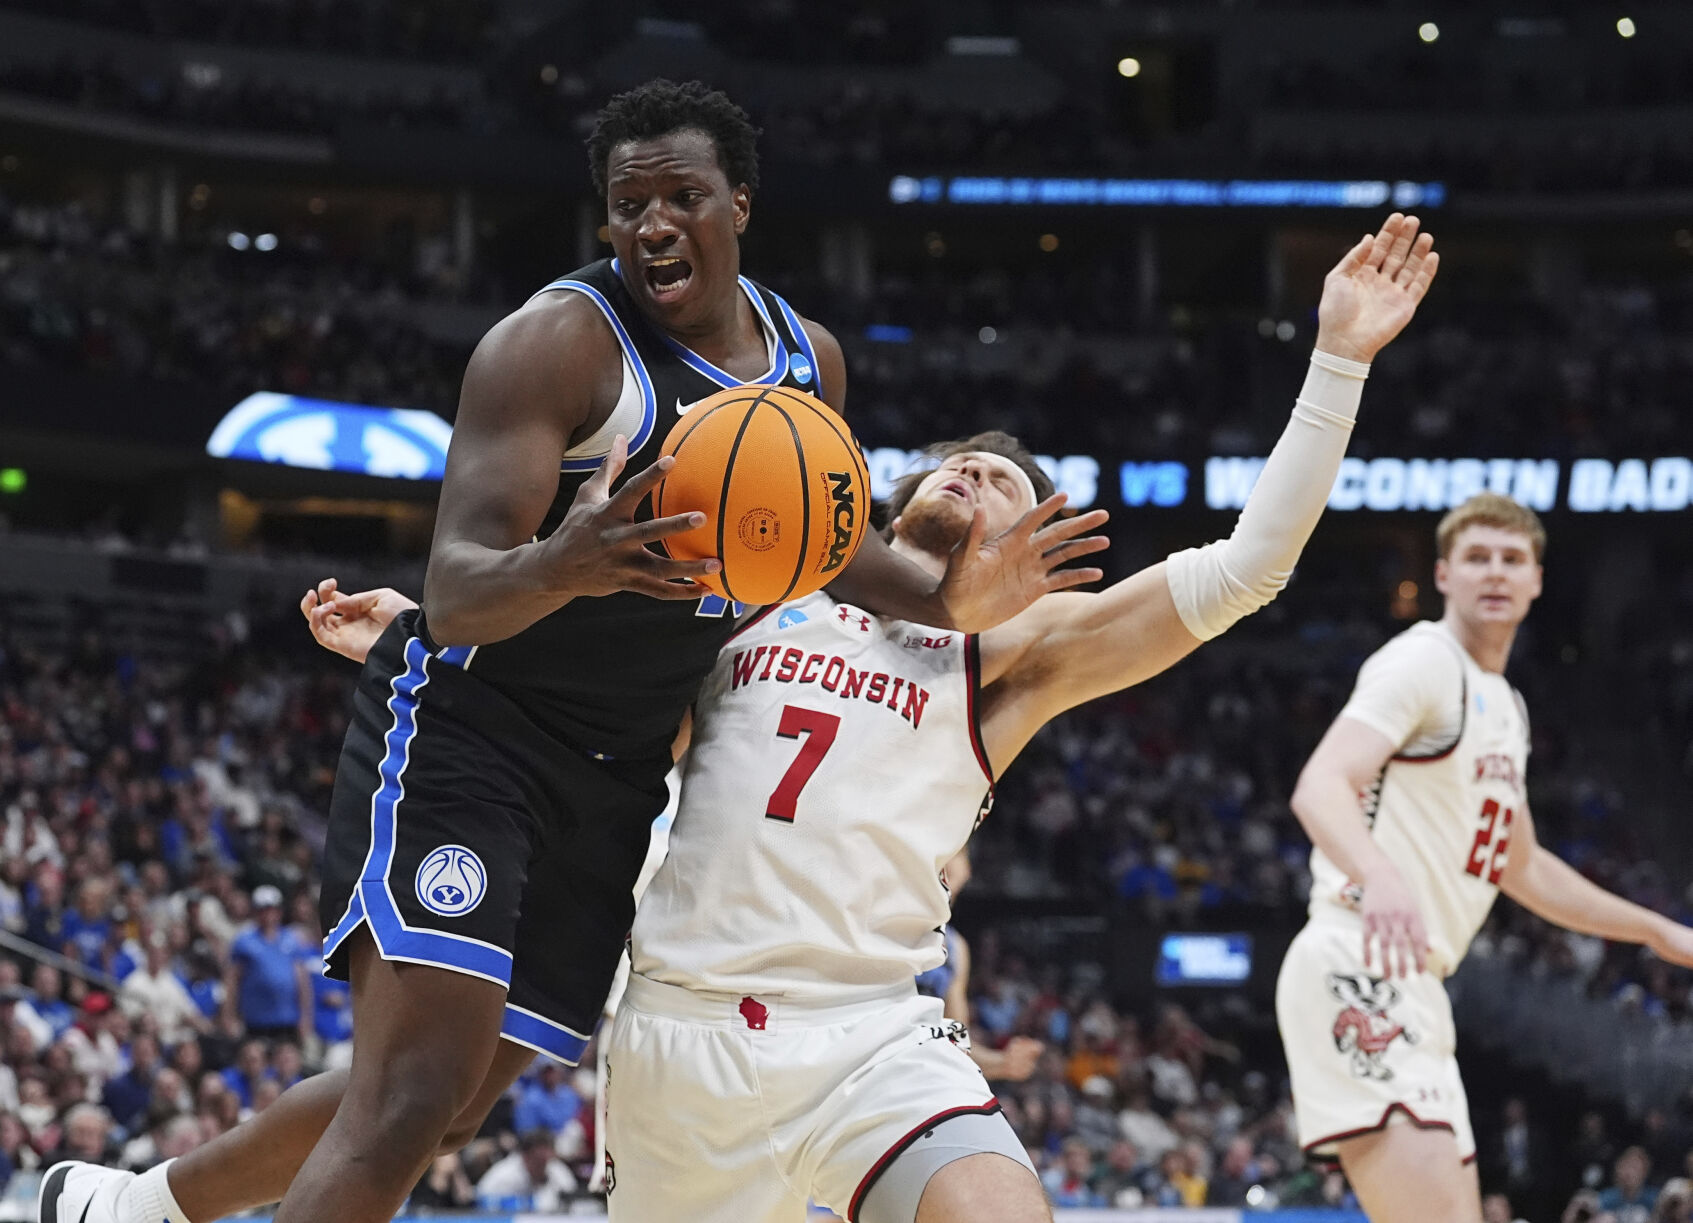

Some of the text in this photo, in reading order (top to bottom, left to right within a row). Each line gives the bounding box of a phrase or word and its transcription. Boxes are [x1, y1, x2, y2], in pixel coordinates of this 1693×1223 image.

[813, 472, 831, 575] OFFICIAL GAME BALL
[820, 472, 855, 573] NCAA
[1119, 461, 1188, 507] VS
[1205, 456, 1559, 512] WCONSIN
[731, 645, 931, 730] WISCONSIN
[764, 704, 842, 824] 7
[1464, 797, 1514, 886] 22
[437, 886, 461, 905] Y
